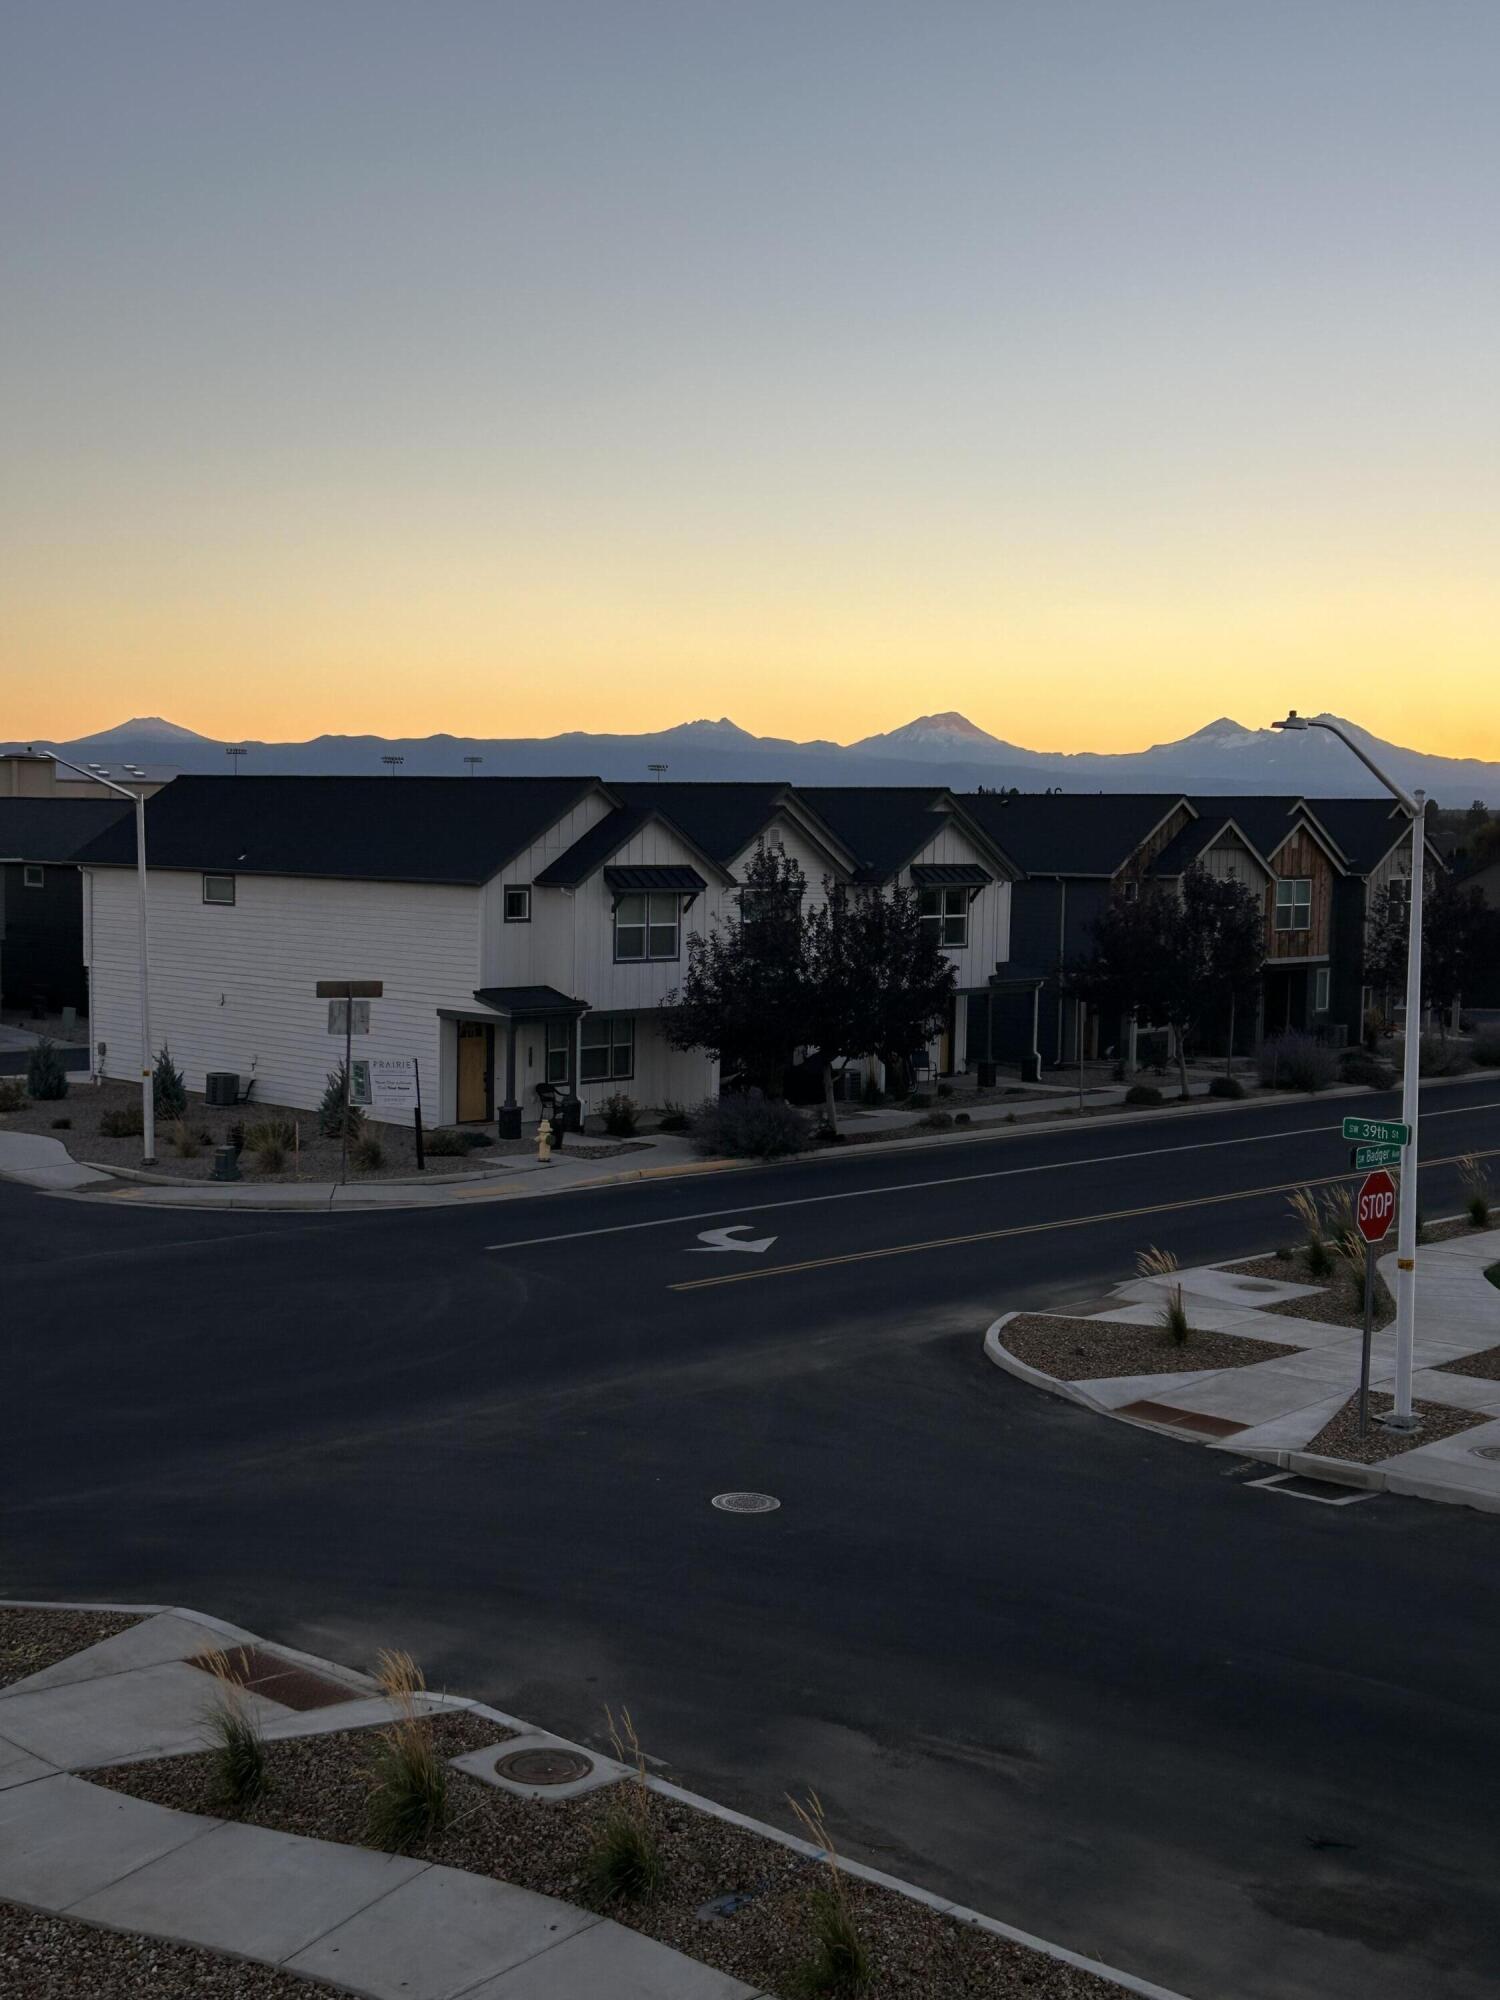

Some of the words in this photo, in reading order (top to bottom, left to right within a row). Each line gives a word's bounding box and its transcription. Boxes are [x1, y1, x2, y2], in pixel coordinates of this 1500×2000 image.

[373, 1060, 411, 1069] PRAIRIE
[1349, 1124, 1359, 1133] SW
[1362, 1123, 1388, 1140] 39th
[1391, 1129, 1399, 1139] St
[1366, 1147, 1391, 1165] Badger
[1360, 1191, 1393, 1221] STOP
